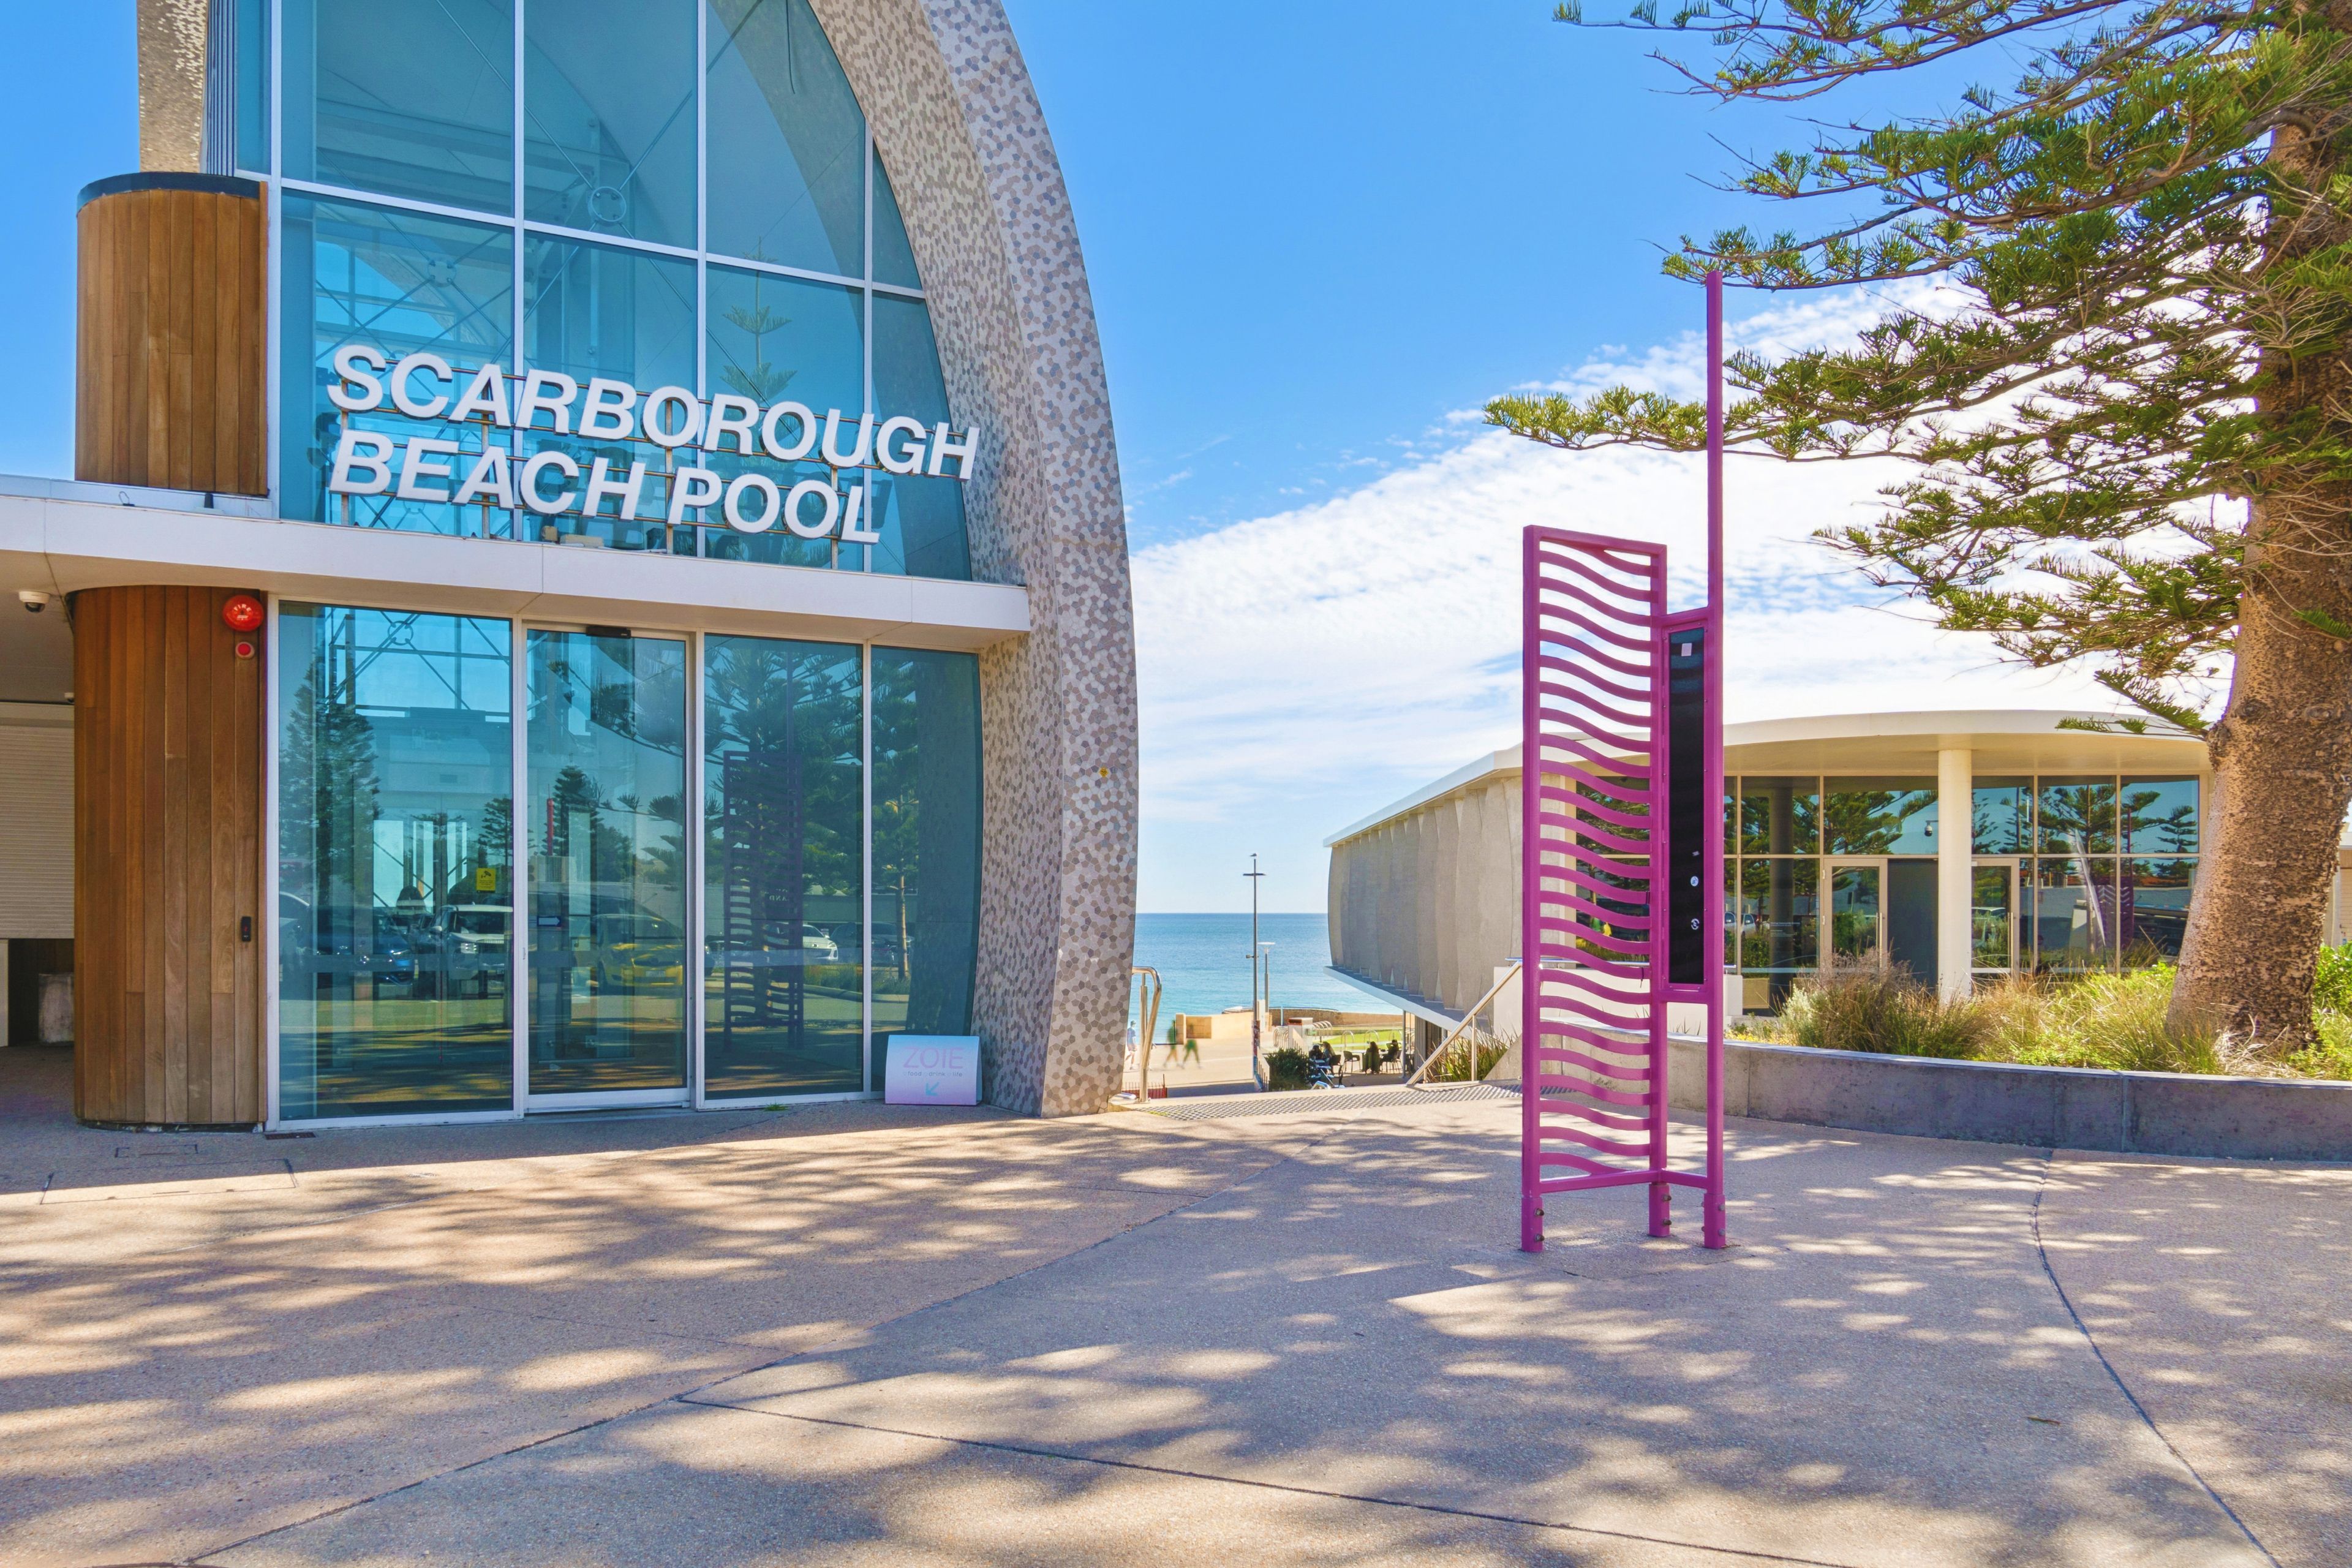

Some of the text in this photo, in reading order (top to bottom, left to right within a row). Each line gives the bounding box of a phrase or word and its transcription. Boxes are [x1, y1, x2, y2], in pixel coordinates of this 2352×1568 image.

[326, 344, 979, 483] SCARBOROUGH
[329, 429, 881, 546] BEACH POOL
[233, 603, 252, 612] FIRE
[902, 1046, 964, 1069] ZOIE
